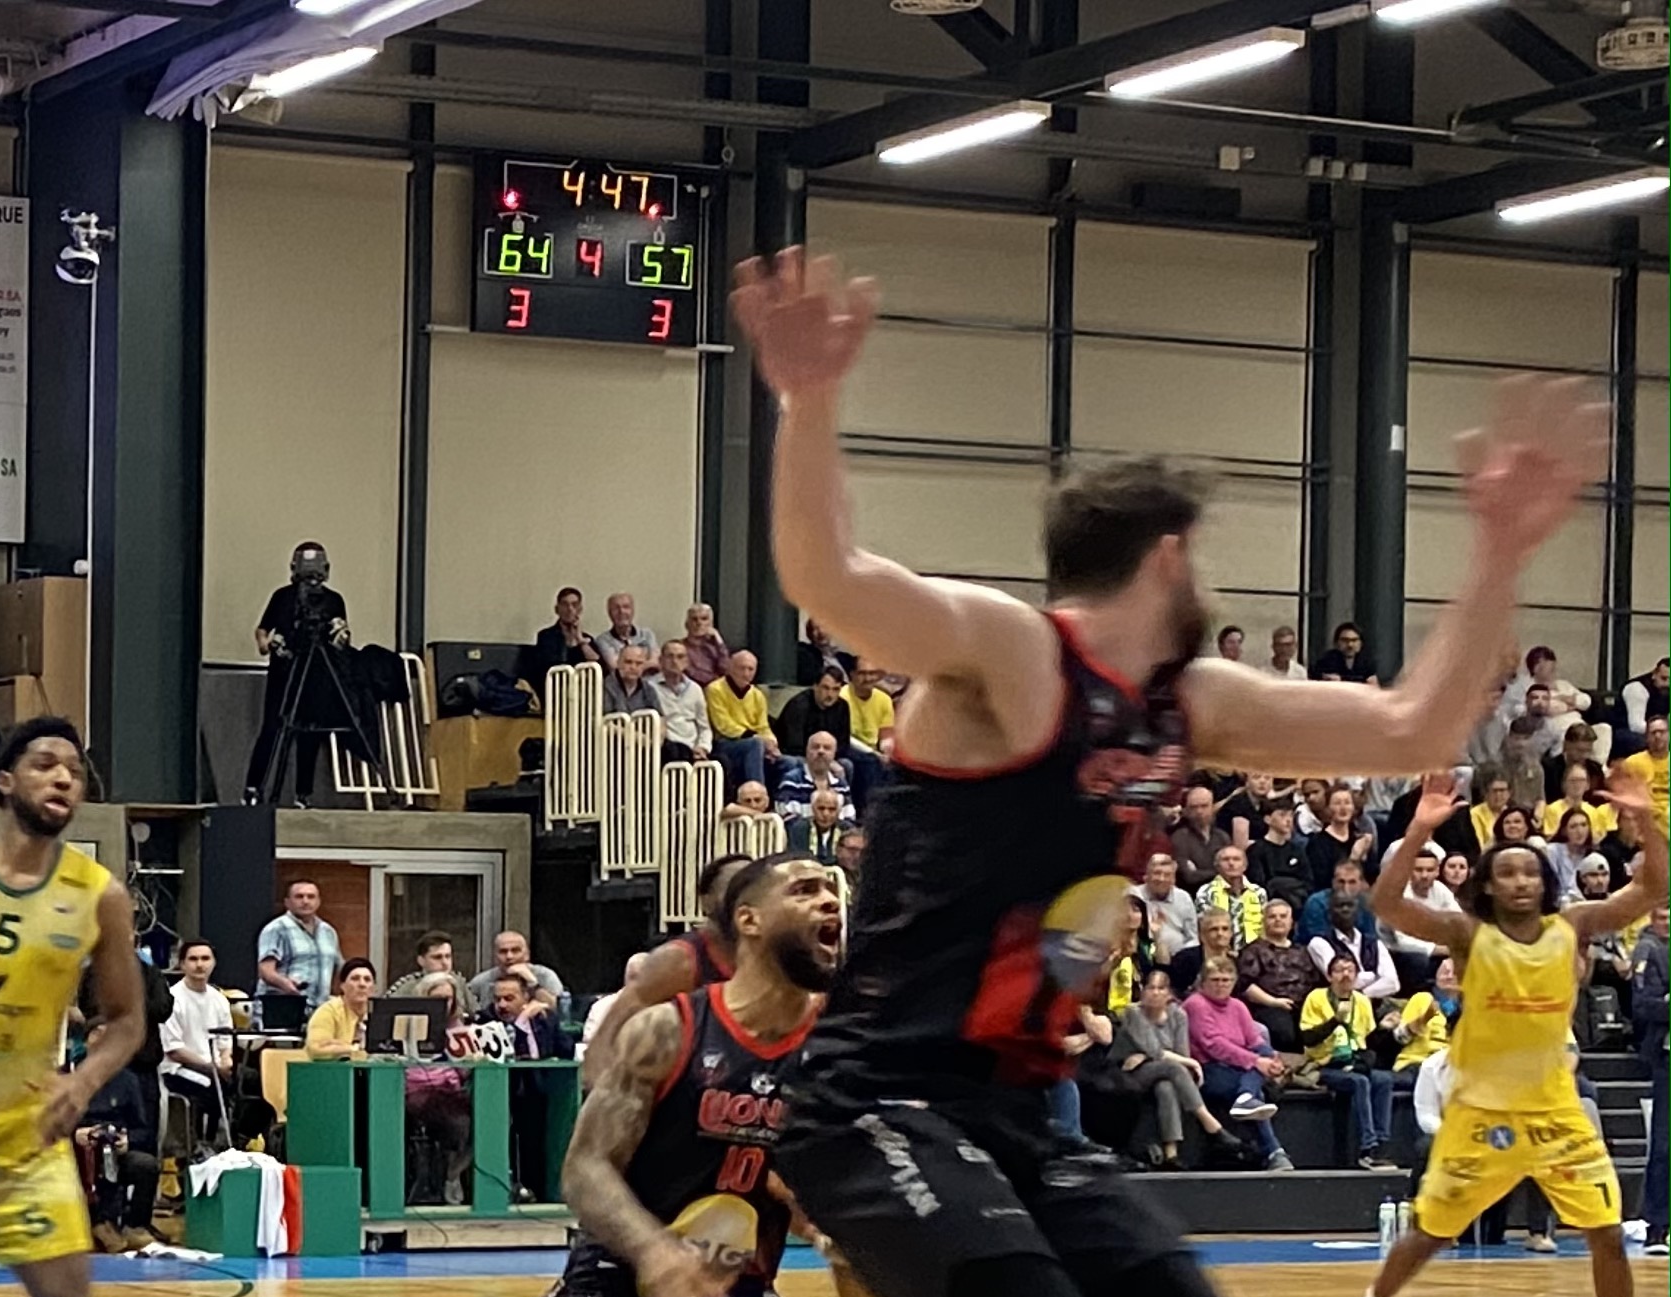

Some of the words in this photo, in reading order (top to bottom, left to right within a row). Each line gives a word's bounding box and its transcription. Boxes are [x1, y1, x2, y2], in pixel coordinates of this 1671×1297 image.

[498, 233, 551, 274] 64
[580, 240, 603, 279] 4
[641, 246, 692, 284] 57
[505, 287, 532, 329] 3
[647, 299, 674, 339] 3
[1, 457, 18, 478] SA
[714, 1145, 766, 1194] 10
